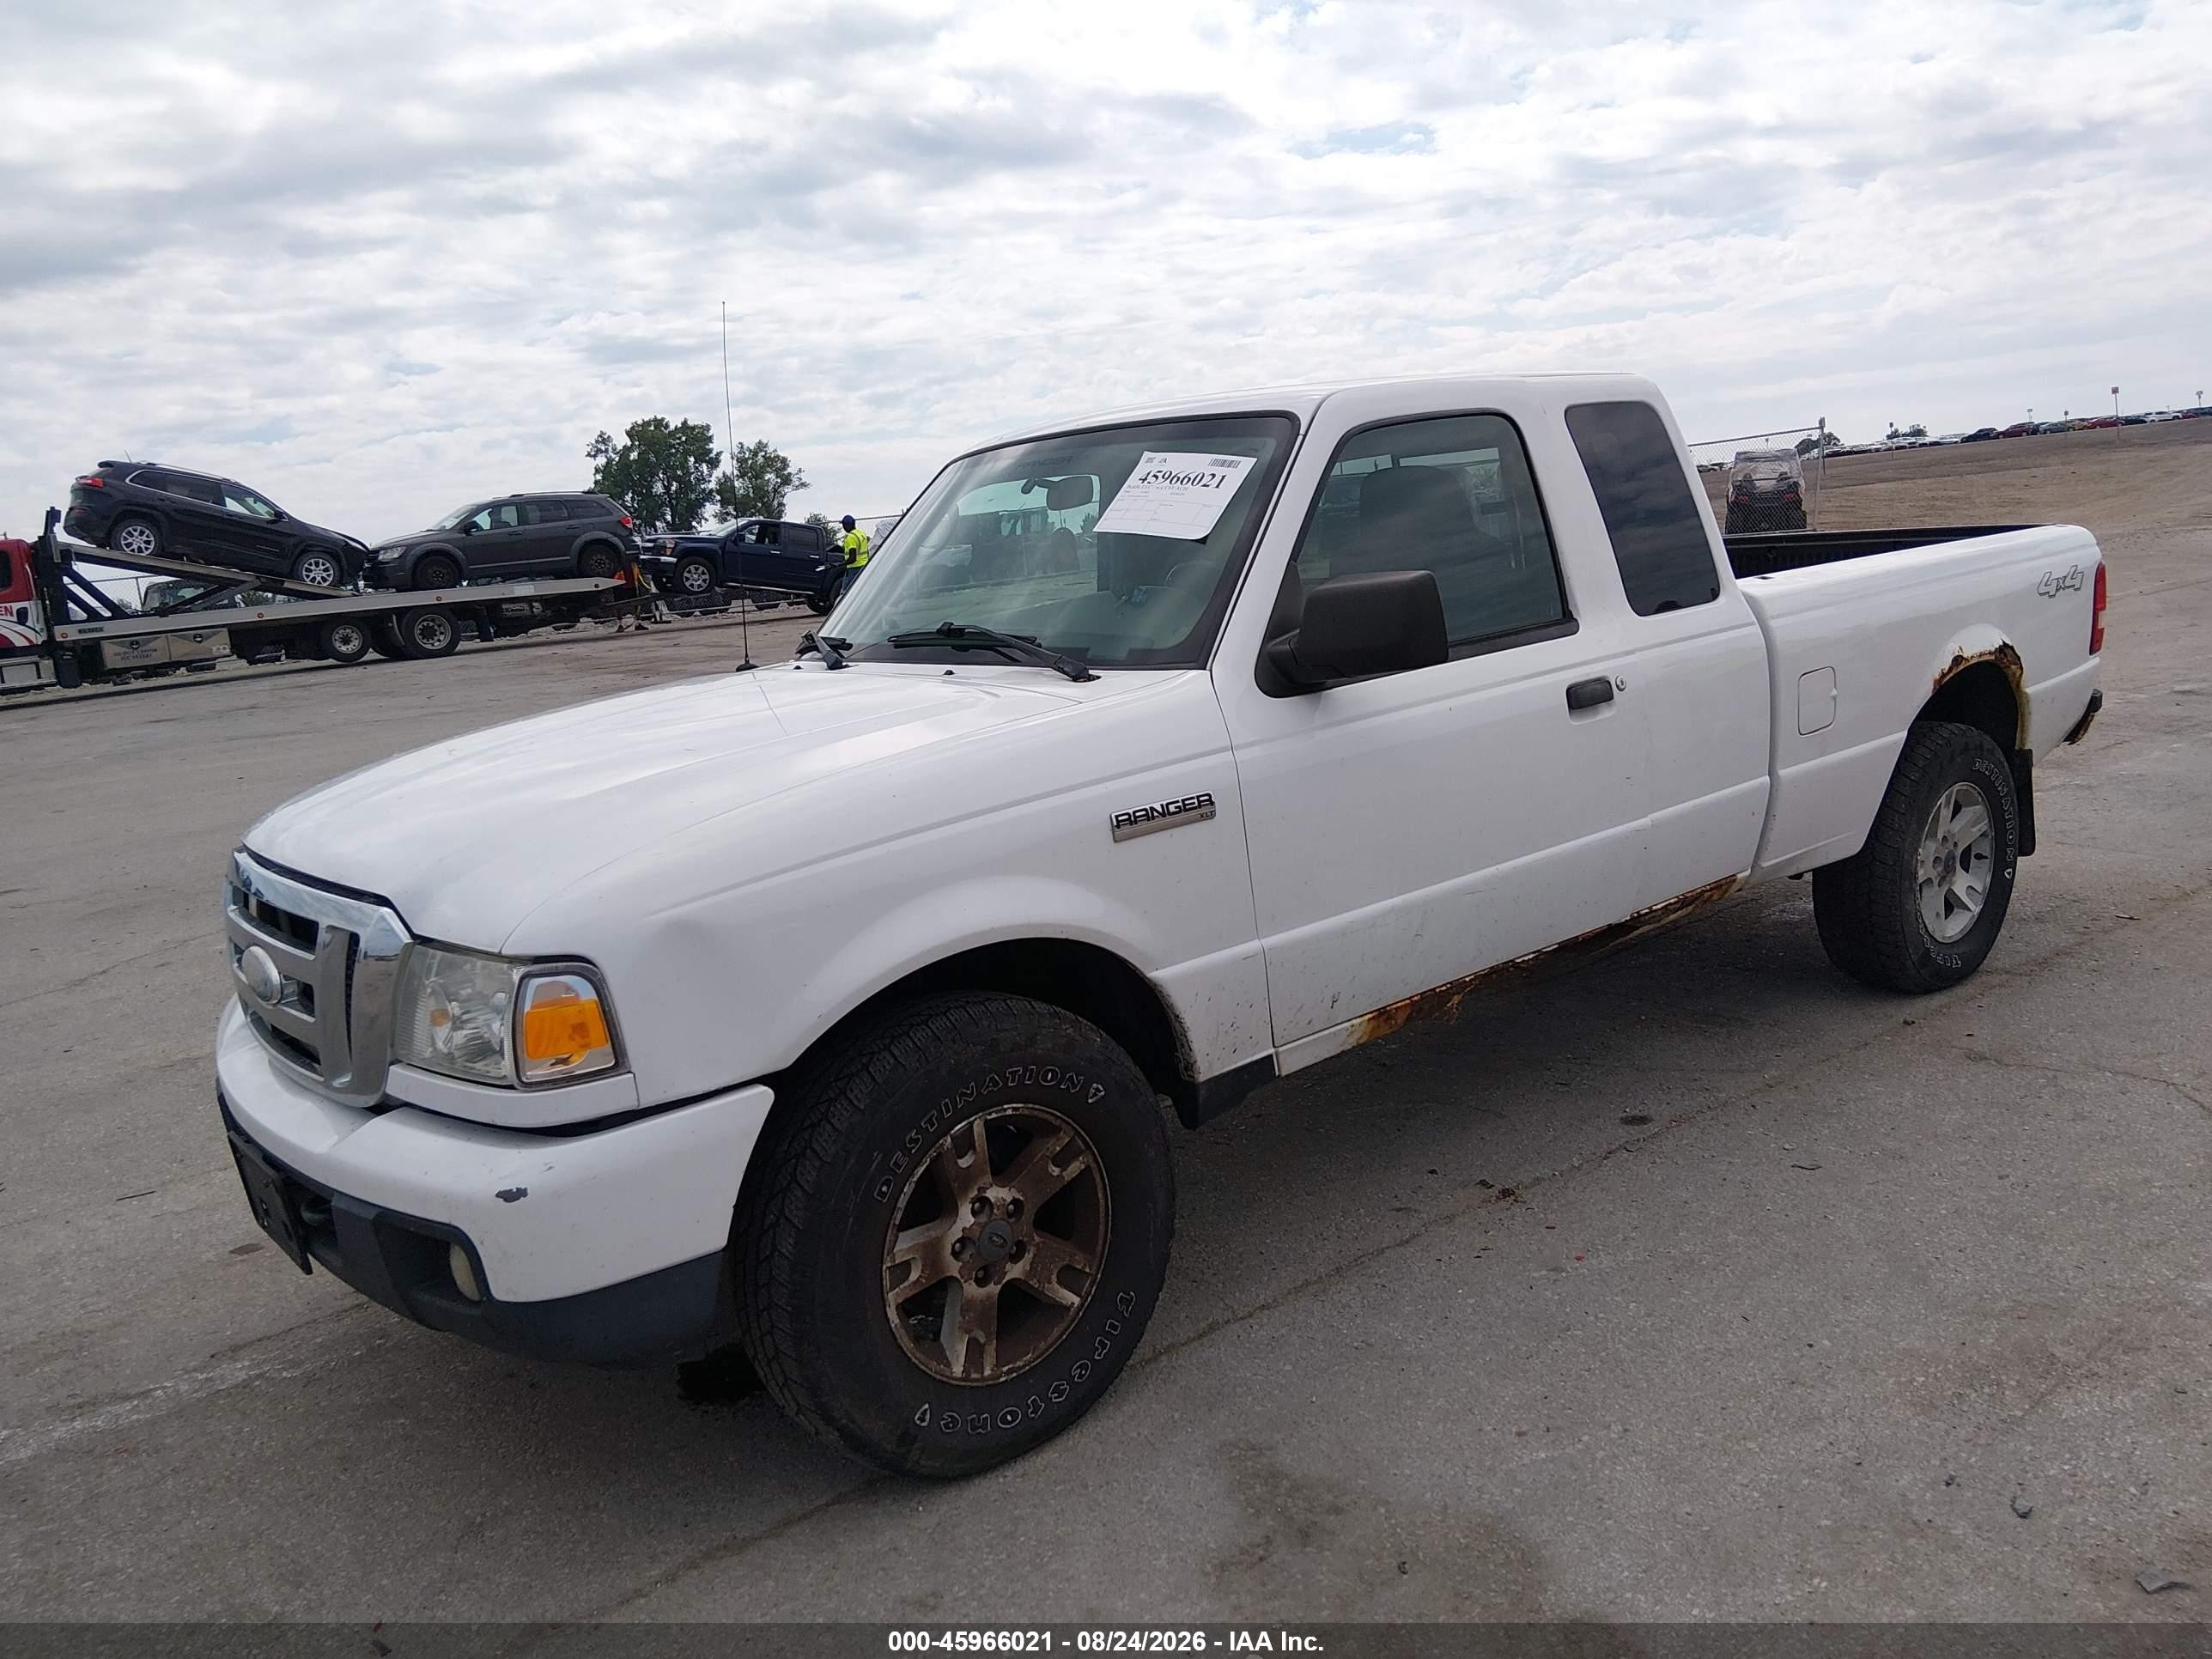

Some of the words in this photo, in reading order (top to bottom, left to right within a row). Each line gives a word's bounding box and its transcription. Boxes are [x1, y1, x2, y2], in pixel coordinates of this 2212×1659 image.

[1138, 469, 1227, 489] 45966021
[2037, 564, 2085, 599] 4x4
[1114, 792, 1215, 830] RANGER
[1972, 758, 2016, 862] DESTINATION
[872, 1065, 1085, 1203] DESTINATION
